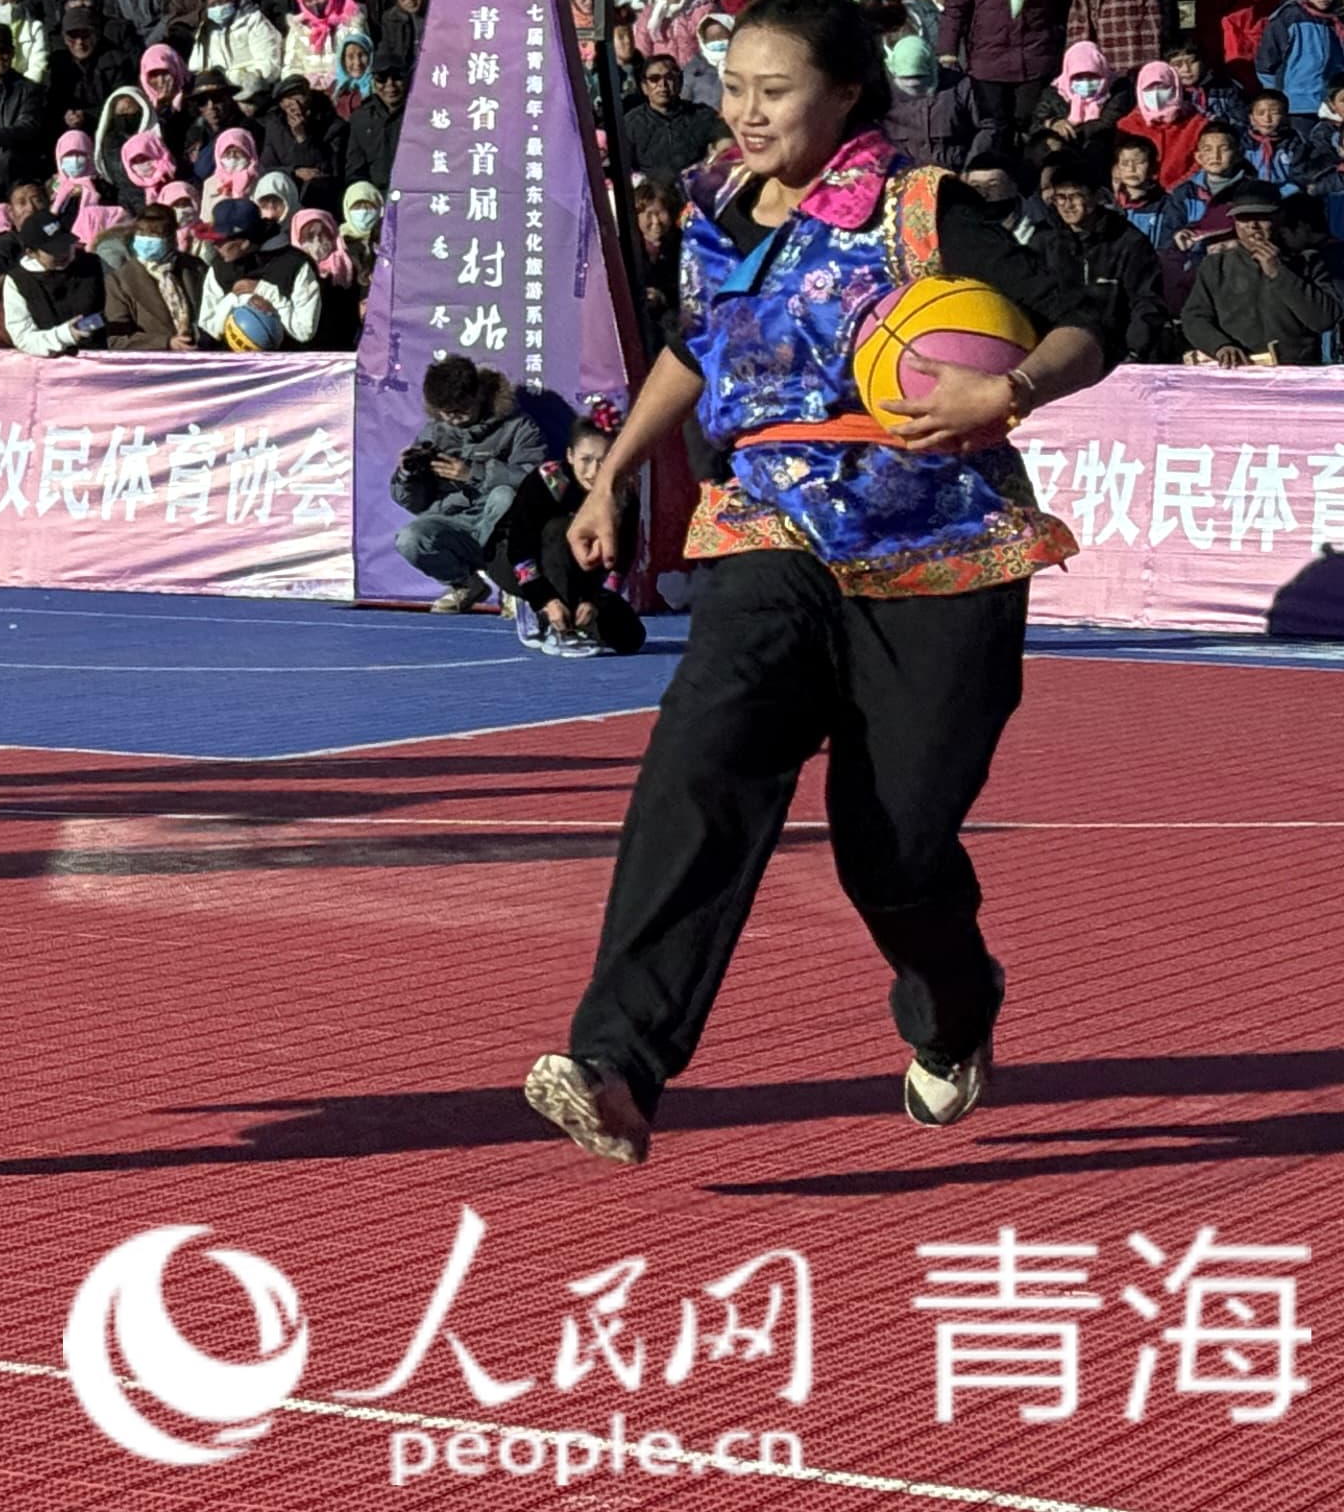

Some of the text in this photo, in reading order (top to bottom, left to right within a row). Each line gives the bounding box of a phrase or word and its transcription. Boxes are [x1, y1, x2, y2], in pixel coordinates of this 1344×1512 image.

[457, 6, 508, 351] 青海省首届村姑
